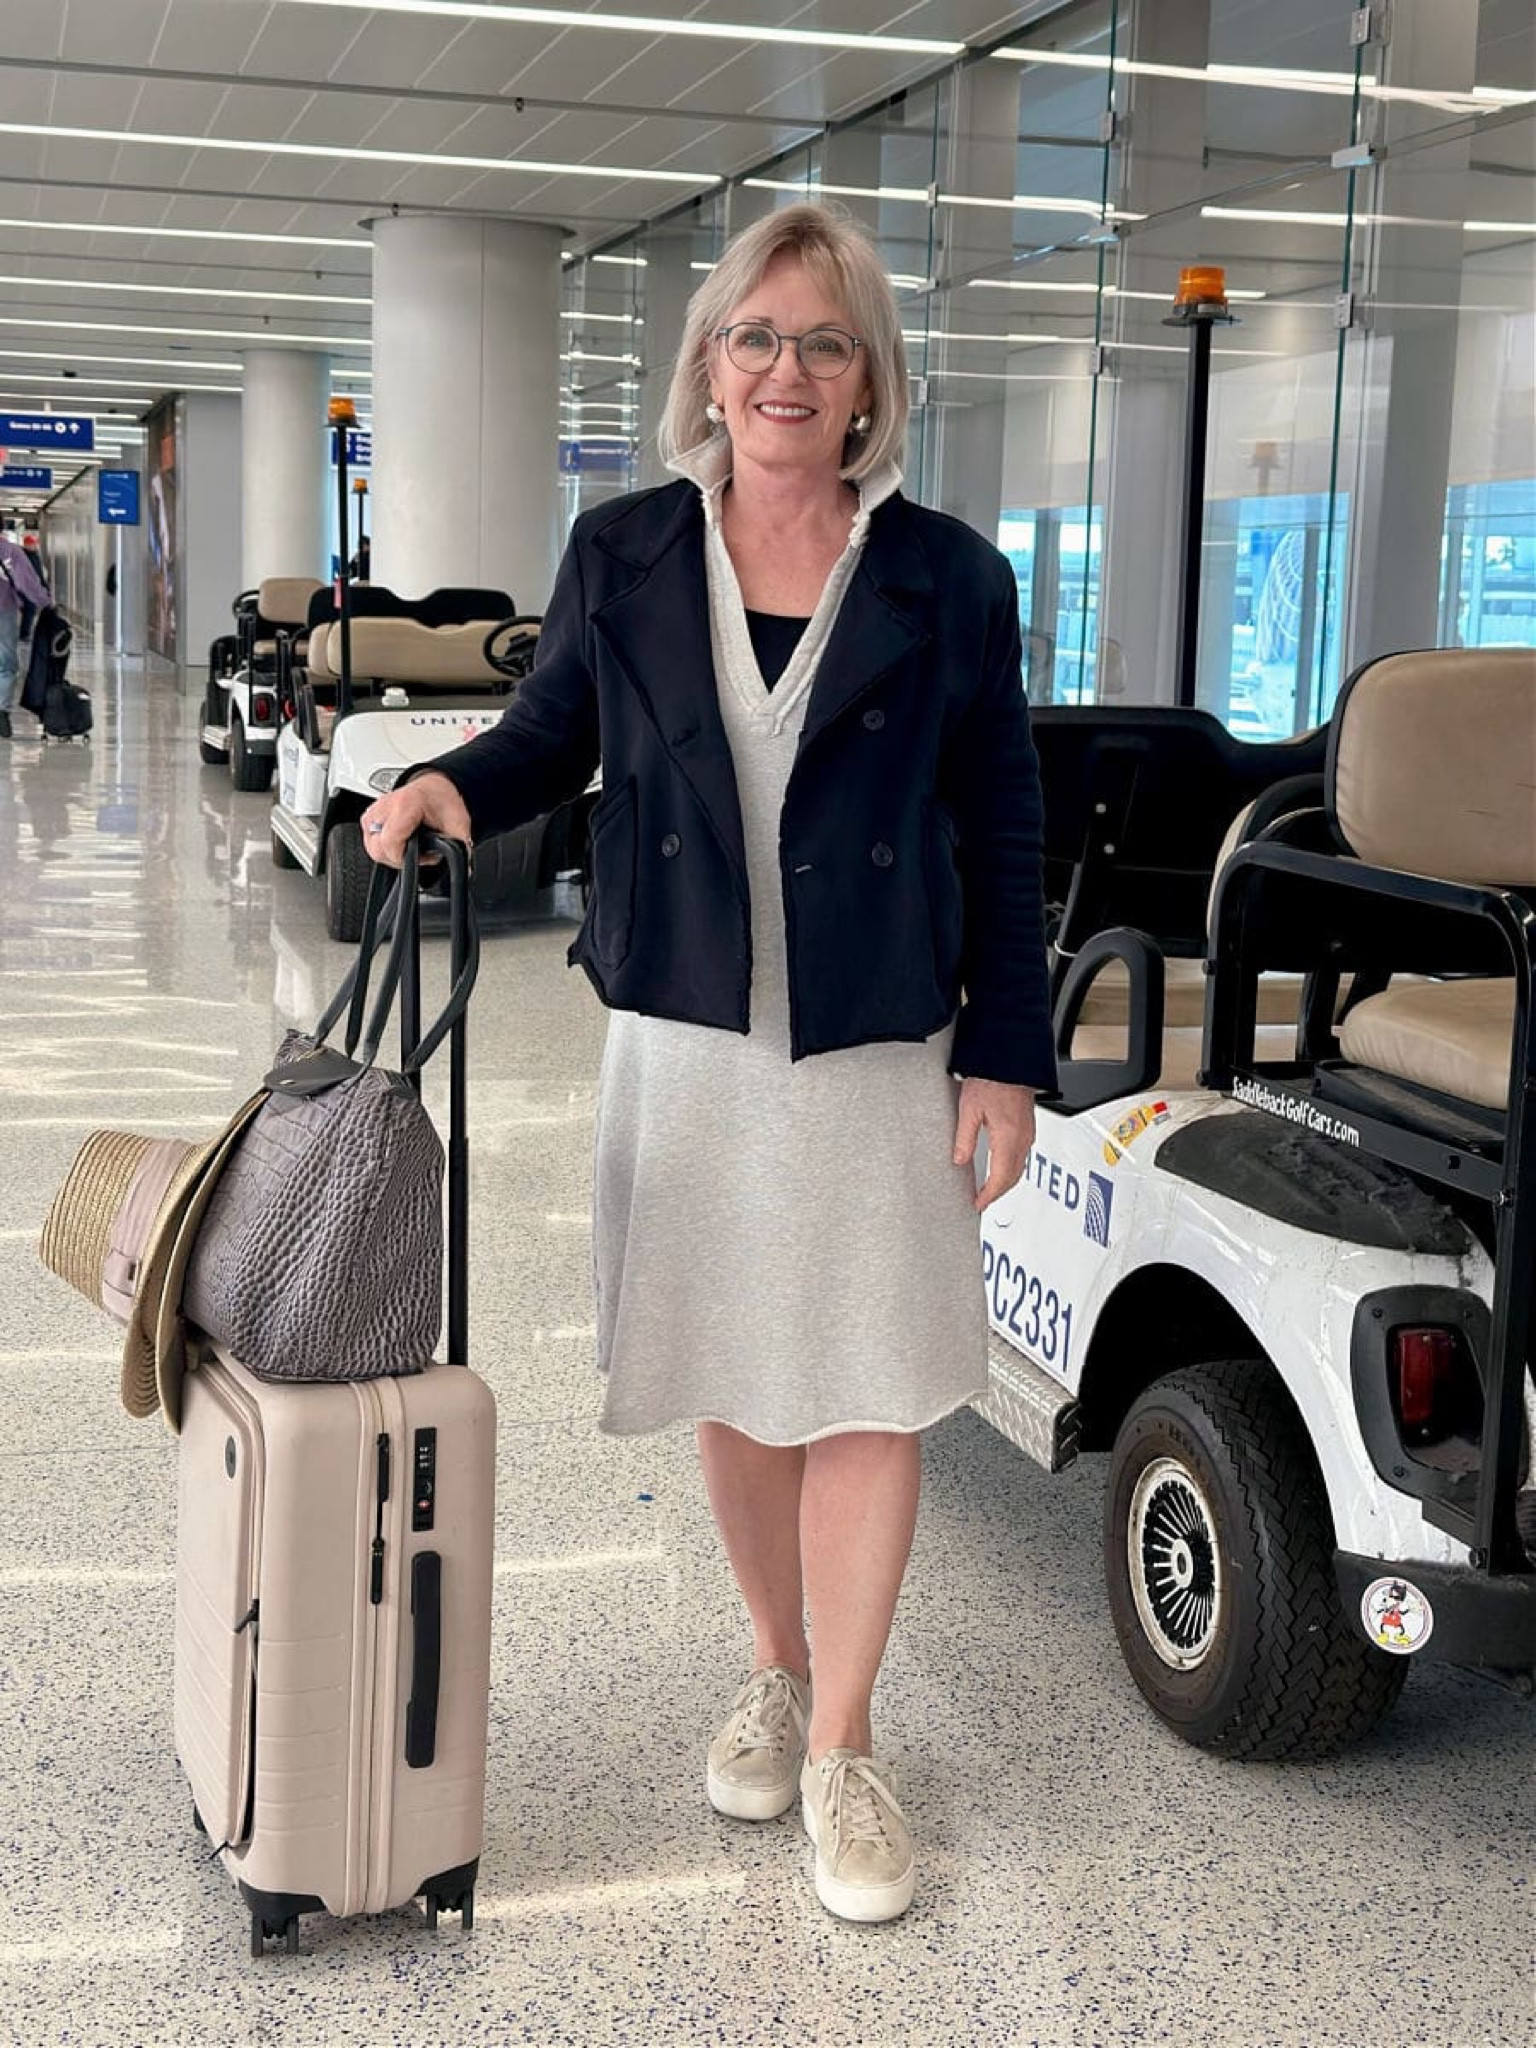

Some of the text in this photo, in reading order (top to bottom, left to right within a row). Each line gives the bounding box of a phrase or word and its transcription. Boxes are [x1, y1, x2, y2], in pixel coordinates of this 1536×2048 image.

[410, 717, 496, 726] UNITE
[1026, 1147, 1080, 1211] ITED
[983, 1240, 1072, 1372] PC2331
